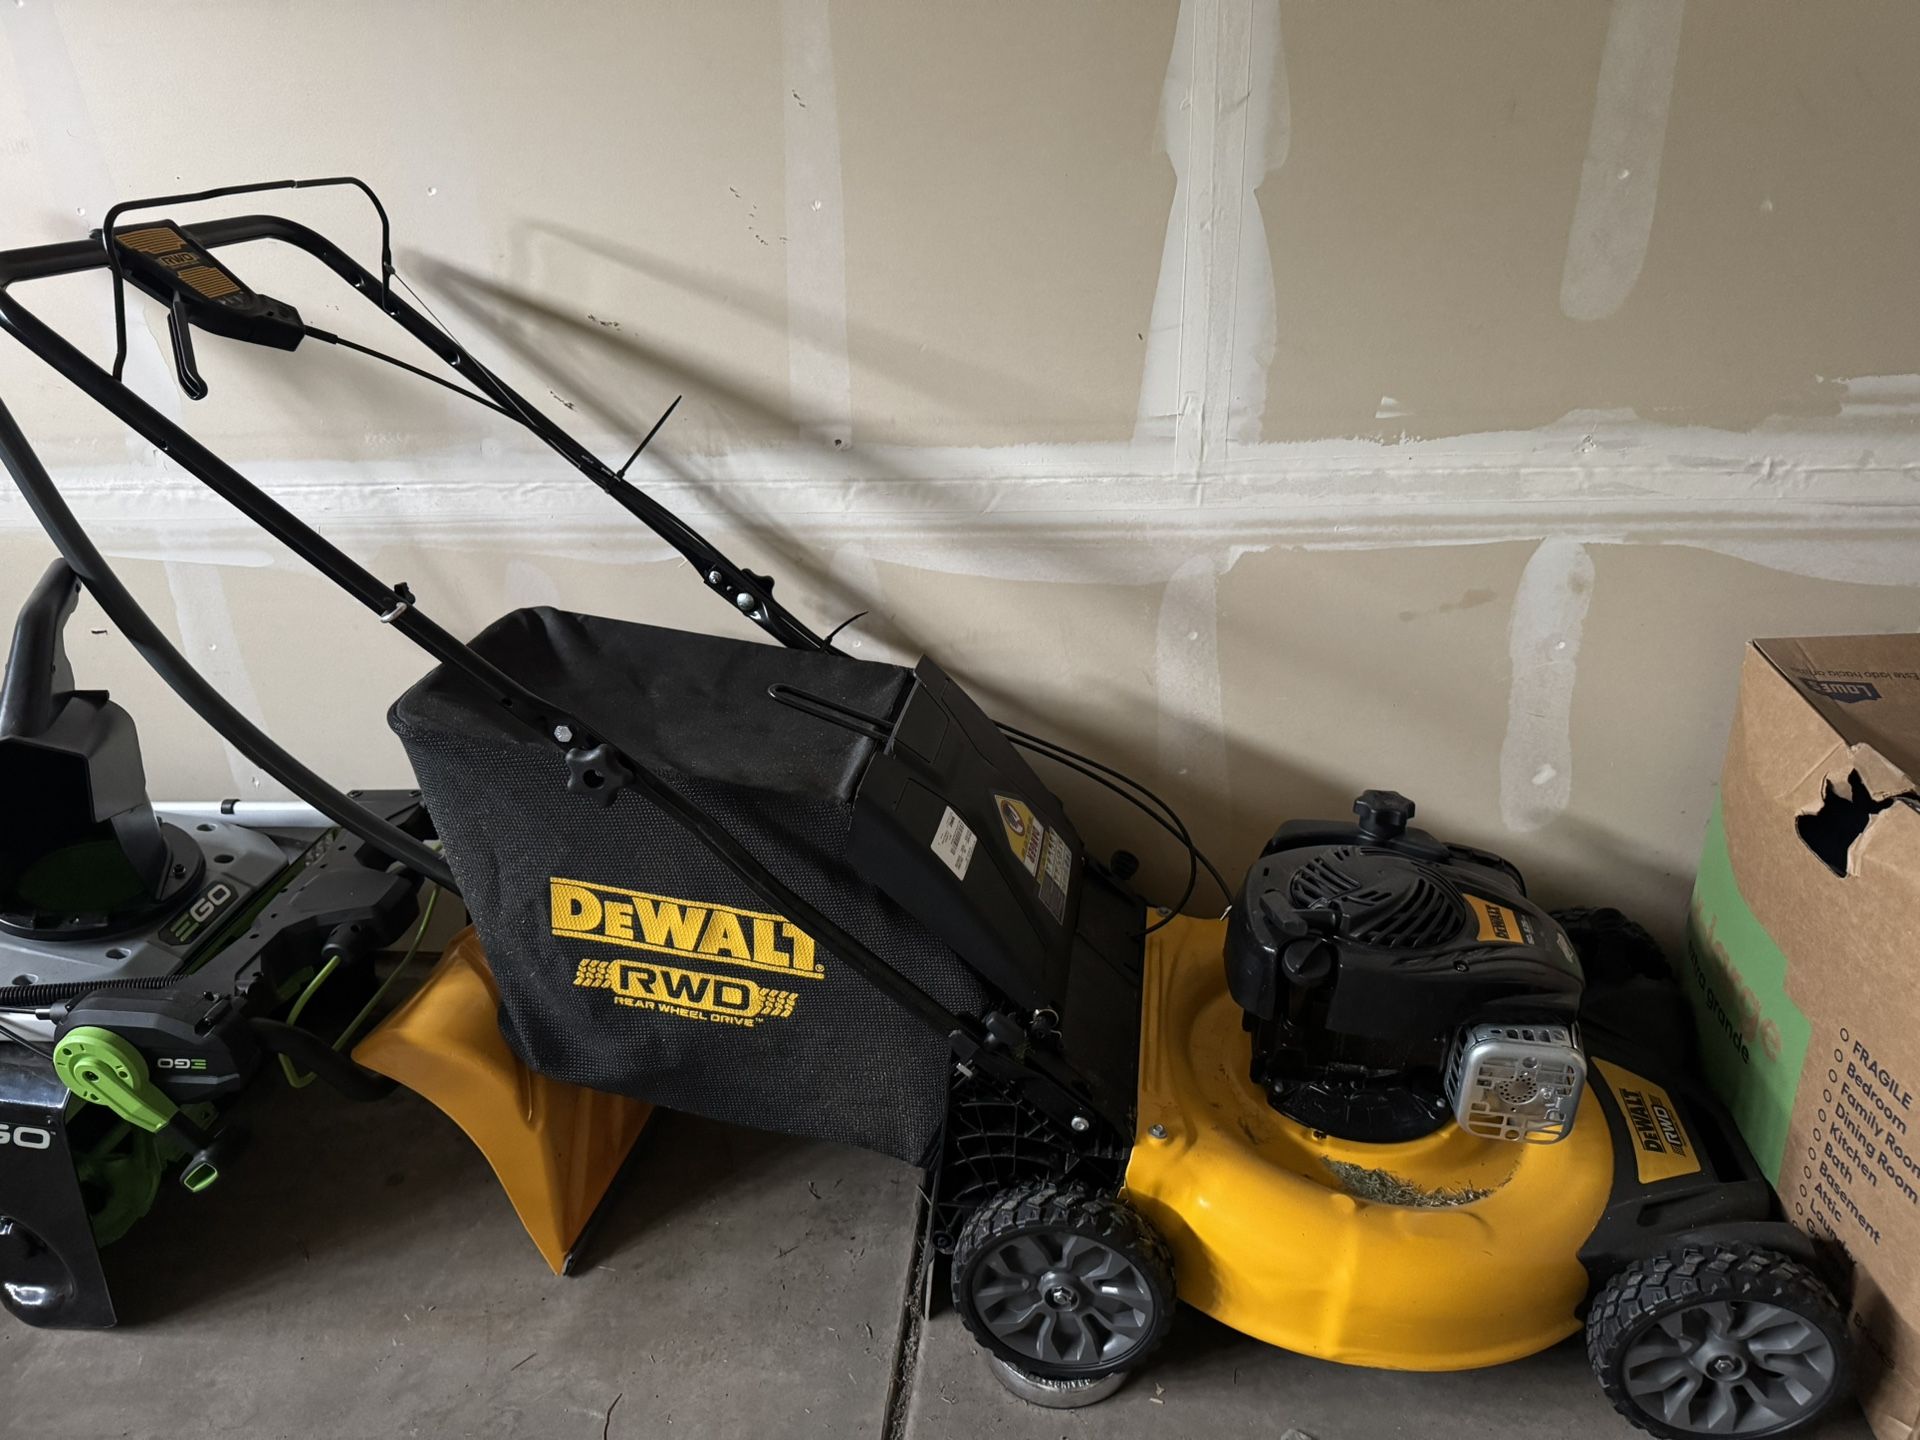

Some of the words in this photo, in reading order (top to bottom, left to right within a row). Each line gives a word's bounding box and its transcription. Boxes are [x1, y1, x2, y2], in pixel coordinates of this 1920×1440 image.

[161, 253, 194, 265] RWD
[1864, 671, 1893, 681] lado
[170, 883, 232, 942] EGO
[550, 883, 815, 972] DEWALT
[613, 995, 656, 1011] REAR
[657, 1002, 708, 1021] WHEEL
[710, 1013, 756, 1029] DRIVE
[617, 964, 752, 1011] RWD
[1706, 987, 1751, 1065] grande
[157, 1057, 207, 1070] EGO
[1853, 1040, 1912, 1111] FRAGILE
[1621, 1088, 1665, 1153] DEWALT
[1652, 1105, 1681, 1145] RWD
[1840, 1082, 1884, 1137] Family
[1846, 1062, 1907, 1135] Bedroom
[1824, 1141, 1854, 1184] Bath
[1829, 1121, 1879, 1188] Kitchen
[1835, 1102, 1876, 1159] Dining
[1876, 1151, 1919, 1205] Room
[1814, 1182, 1842, 1223] Attic
[1819, 1161, 1882, 1246] Basement
